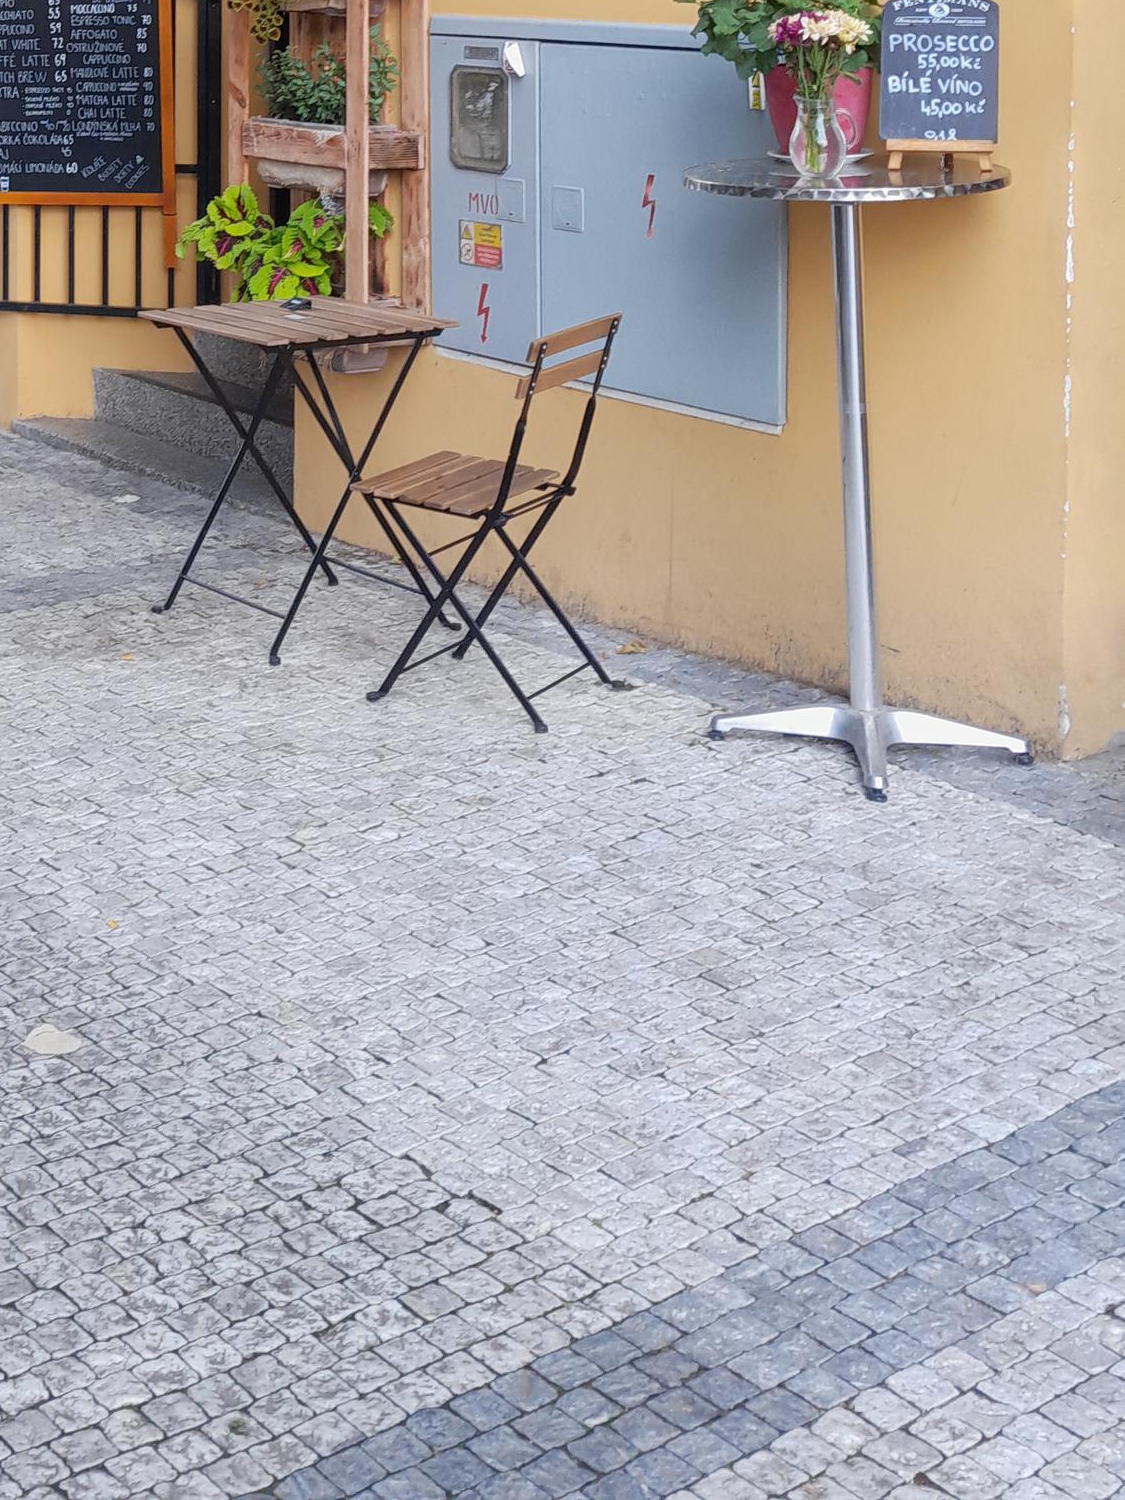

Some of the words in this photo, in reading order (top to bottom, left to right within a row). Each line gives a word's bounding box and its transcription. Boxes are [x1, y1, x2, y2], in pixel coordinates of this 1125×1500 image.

[48, 7, 60, 19] 55
[50, 22, 61, 34] 59
[70, 28, 117, 40] AFFOGATO
[136, 27, 148, 39] 85
[11, 38, 41, 51] WHITE
[51, 37, 64, 49] 72
[889, 33, 995, 52] PROSECCO
[21, 54, 50, 67] LATTE
[54, 53, 67, 67] 69
[17, 70, 47, 83] BREW
[55, 70, 67, 82] 65
[112, 66, 139, 79] LATTE
[887, 69, 932, 94] BÍLÉ
[937, 74, 982, 96] VÍNO
[111, 95, 137, 106] LATTE
[77, 107, 97, 119] CHAI
[100, 107, 126, 119] LATTE
[921, 99, 962, 118] 45,00
[63, 134, 74, 145] 65
[66, 162, 78, 174] 60
